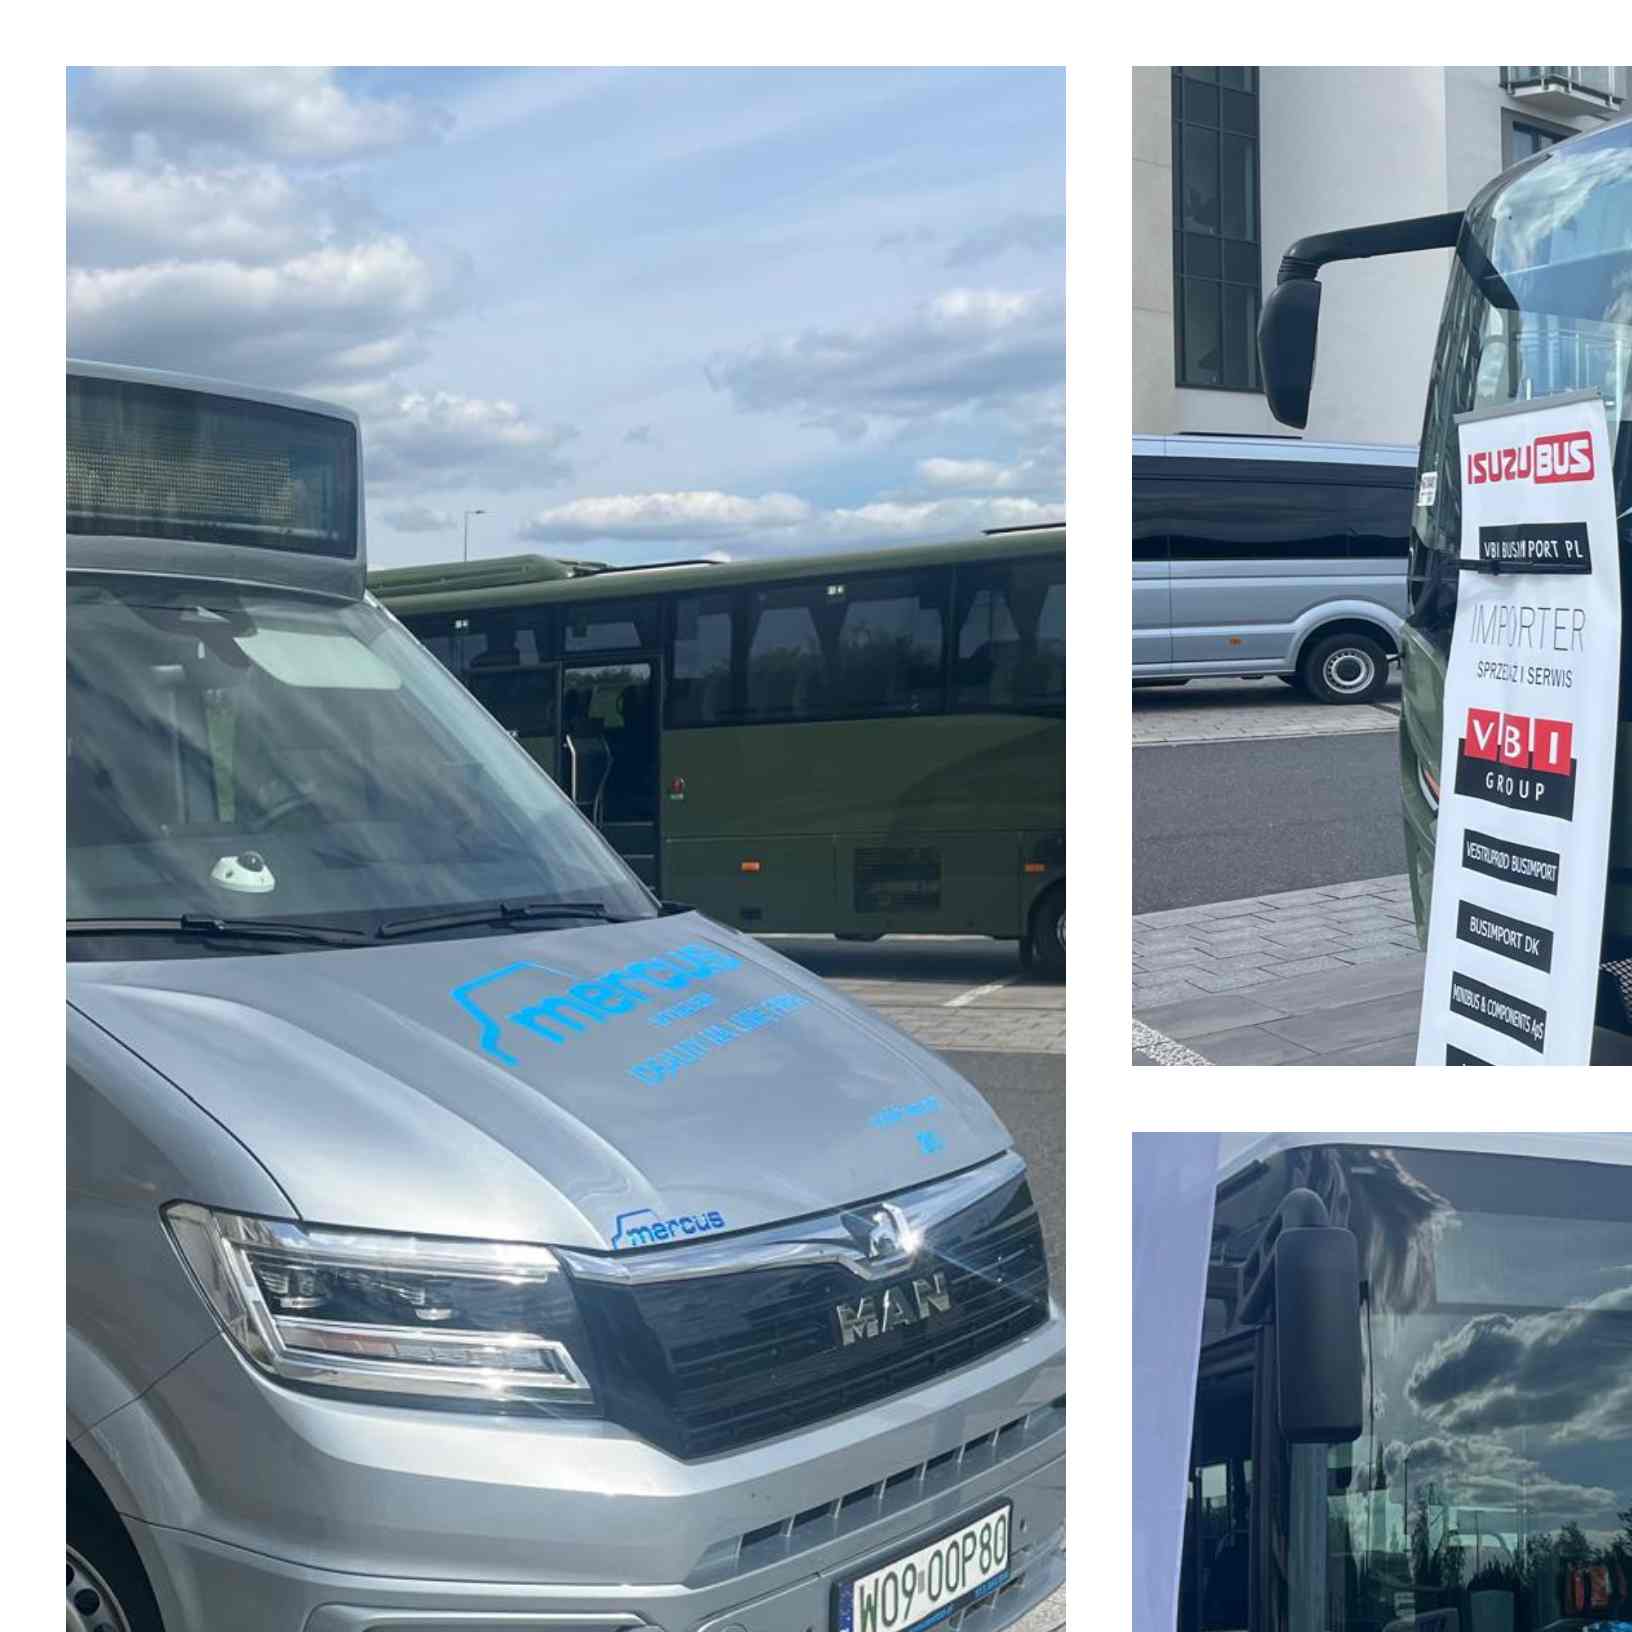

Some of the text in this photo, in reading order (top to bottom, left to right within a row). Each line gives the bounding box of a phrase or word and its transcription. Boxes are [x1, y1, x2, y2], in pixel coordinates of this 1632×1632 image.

[1468, 439, 1592, 484] ISUZU BUS
[1565, 540, 1584, 558] PL
[1470, 603, 1586, 652] IMPORTER
[1527, 666, 1573, 689] SERWIS
[1472, 719, 1559, 765] VBI
[1485, 771, 1545, 801] GROUP
[1511, 855, 1558, 882] BUSIMPORT
[1469, 916, 1540, 956] BUSIMPORT DK
[626, 1209, 725, 1249] mercus
[836, 1271, 951, 1346] MAN
